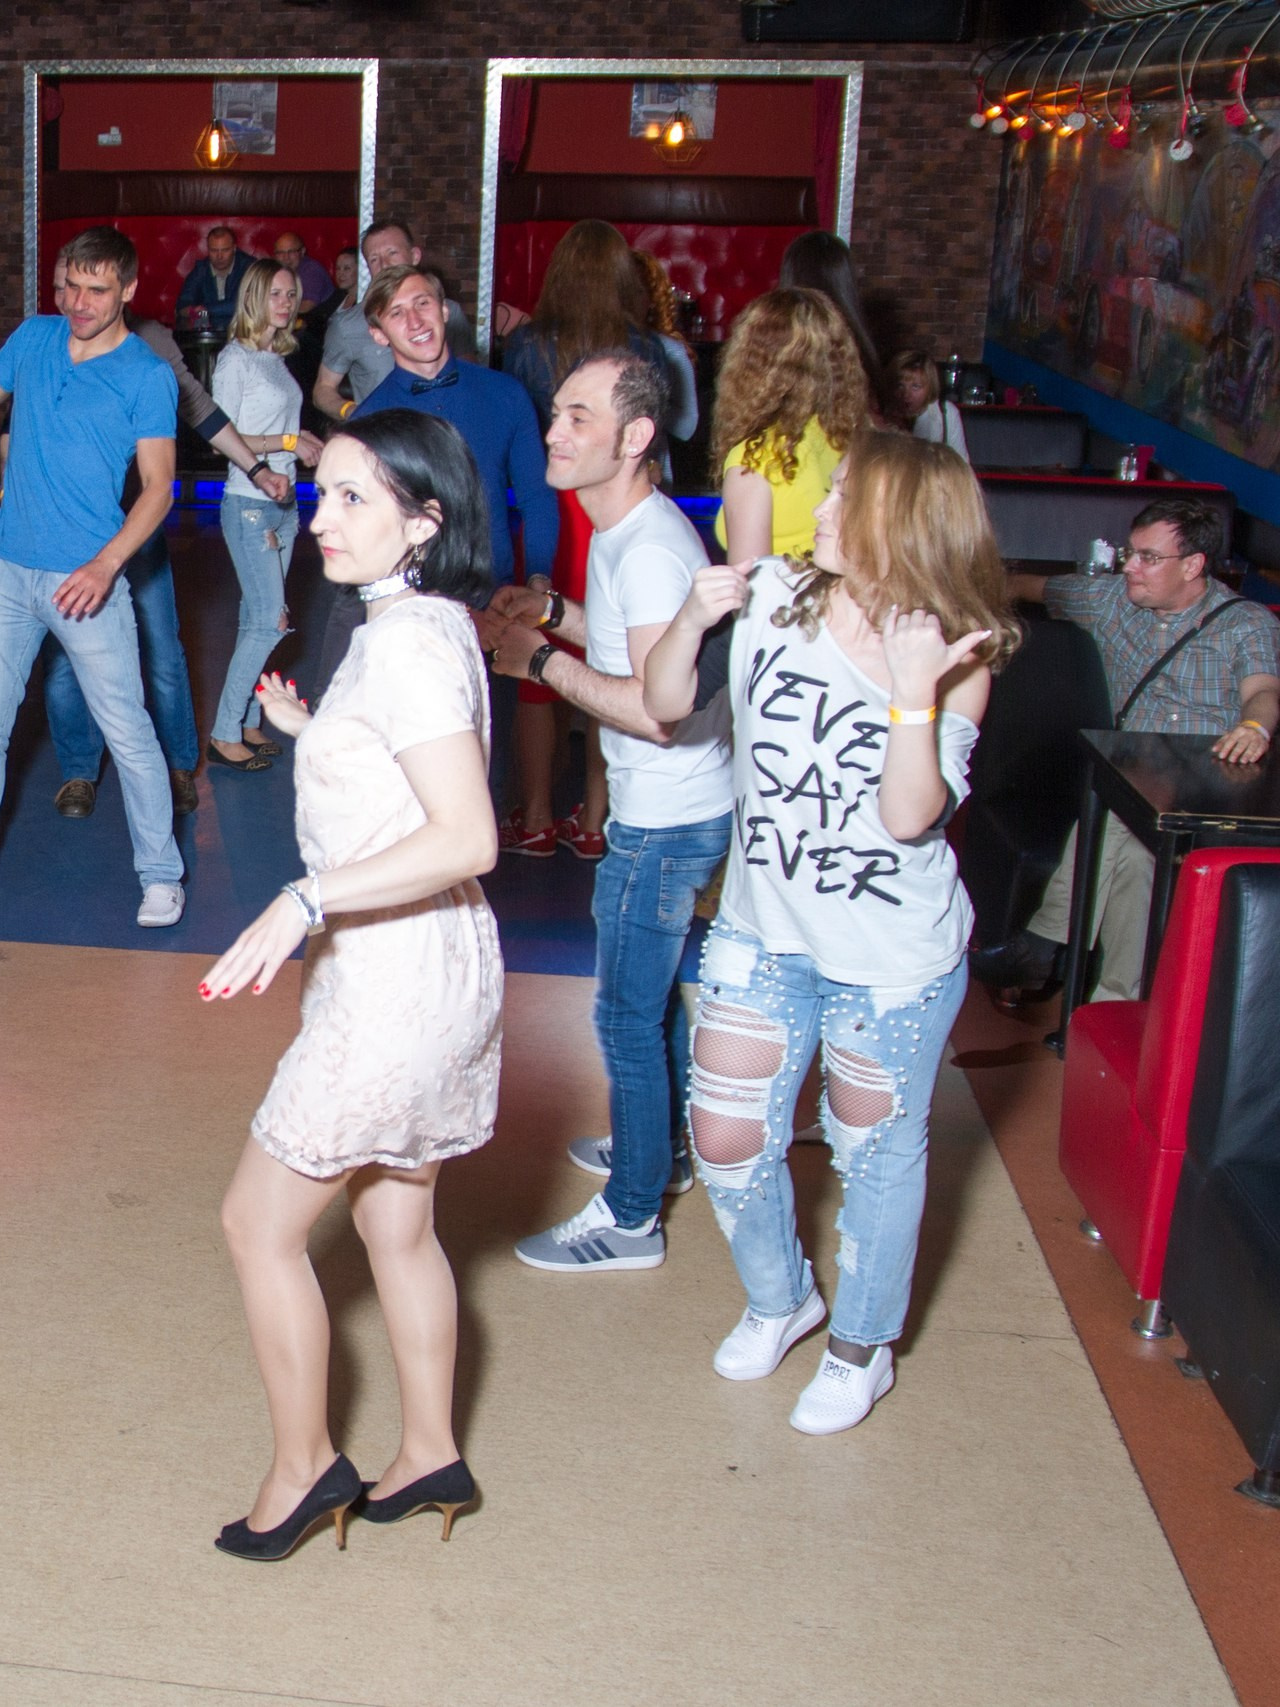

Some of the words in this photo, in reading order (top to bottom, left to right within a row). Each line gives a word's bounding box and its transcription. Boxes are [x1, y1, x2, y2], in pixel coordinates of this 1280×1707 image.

[745, 645, 889, 785] NEVE
[751, 742, 869, 832] SAY
[736, 793, 902, 906] NEVER
[823, 1360, 852, 1381] SPORT
